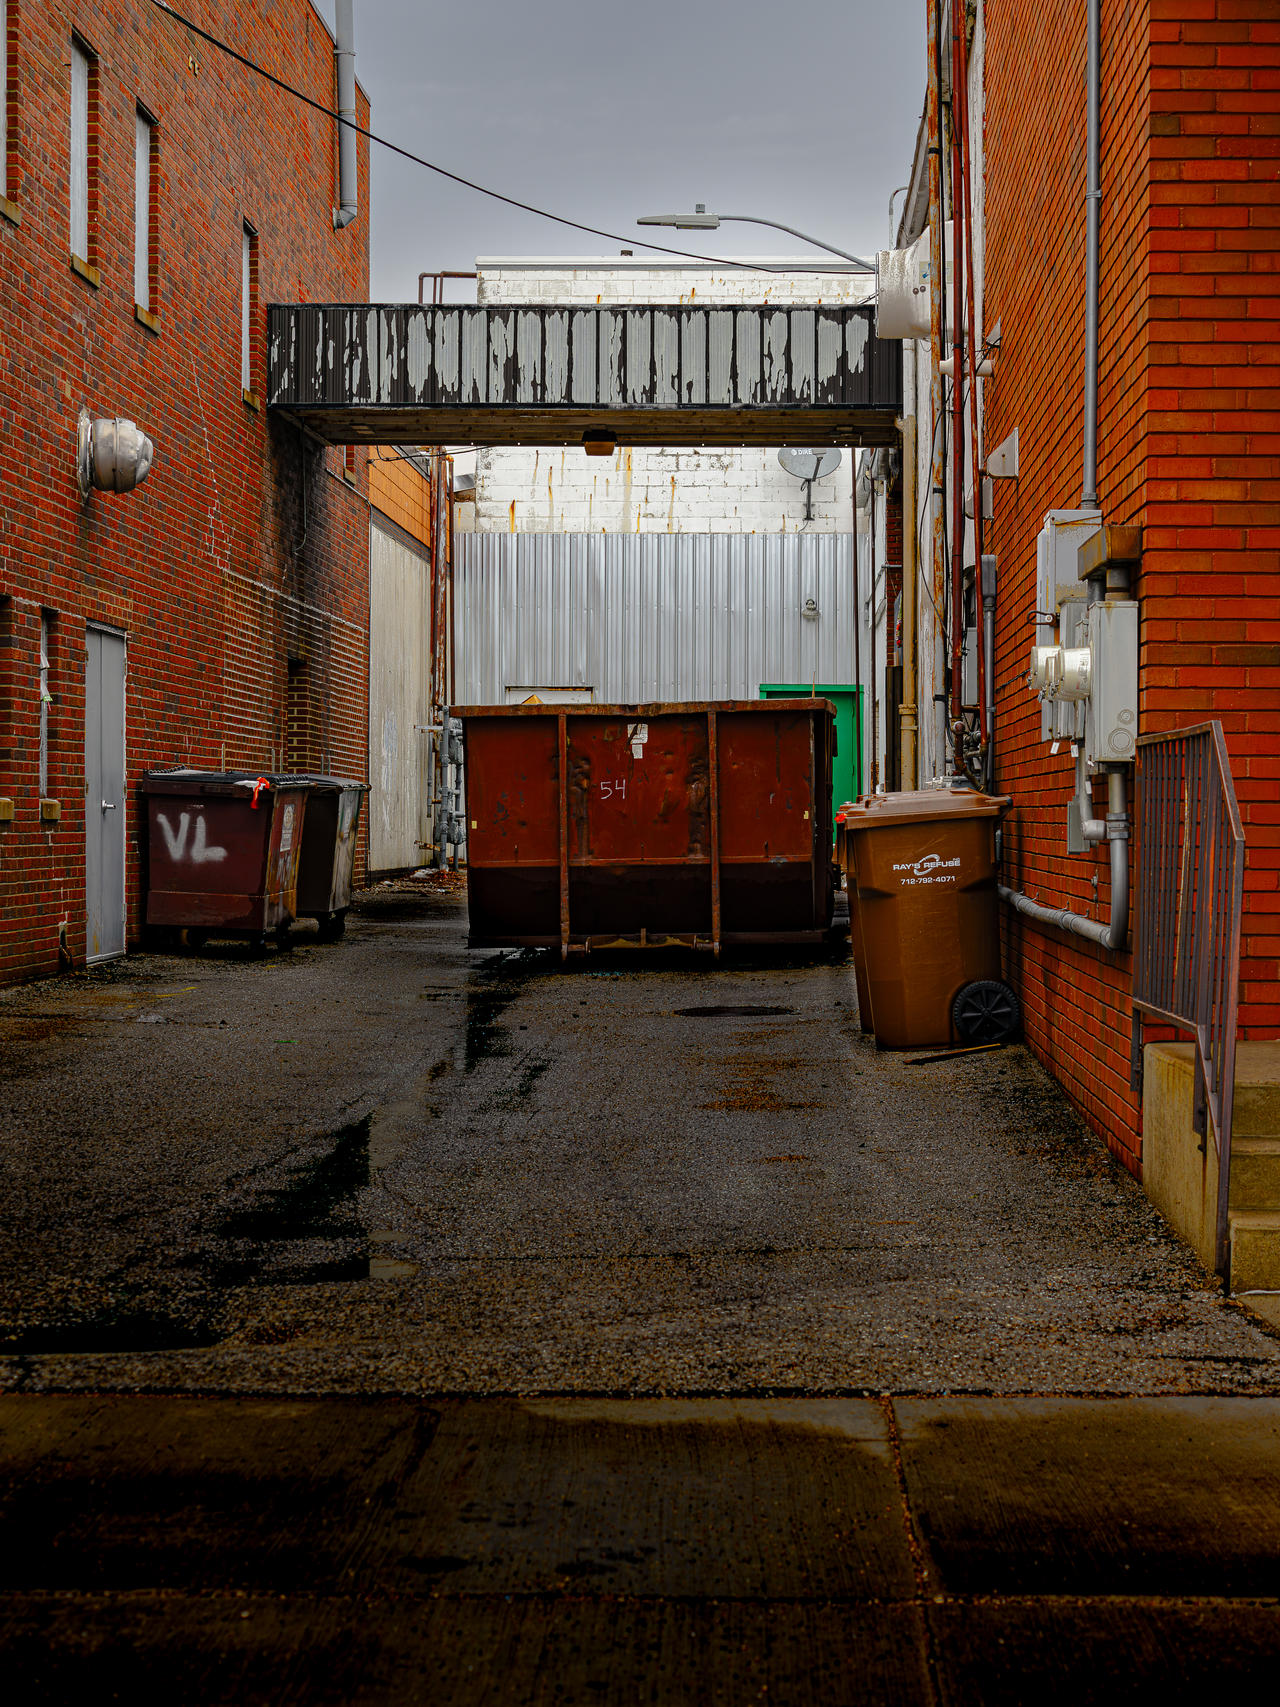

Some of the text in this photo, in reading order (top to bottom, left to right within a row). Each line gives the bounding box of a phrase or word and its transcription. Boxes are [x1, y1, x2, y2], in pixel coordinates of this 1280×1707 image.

[600, 779, 626, 800] 54
[157, 812, 228, 864] VL
[892, 860, 961, 871] RAY'S REFUSE
[901, 875, 956, 885] 712-792-4071
